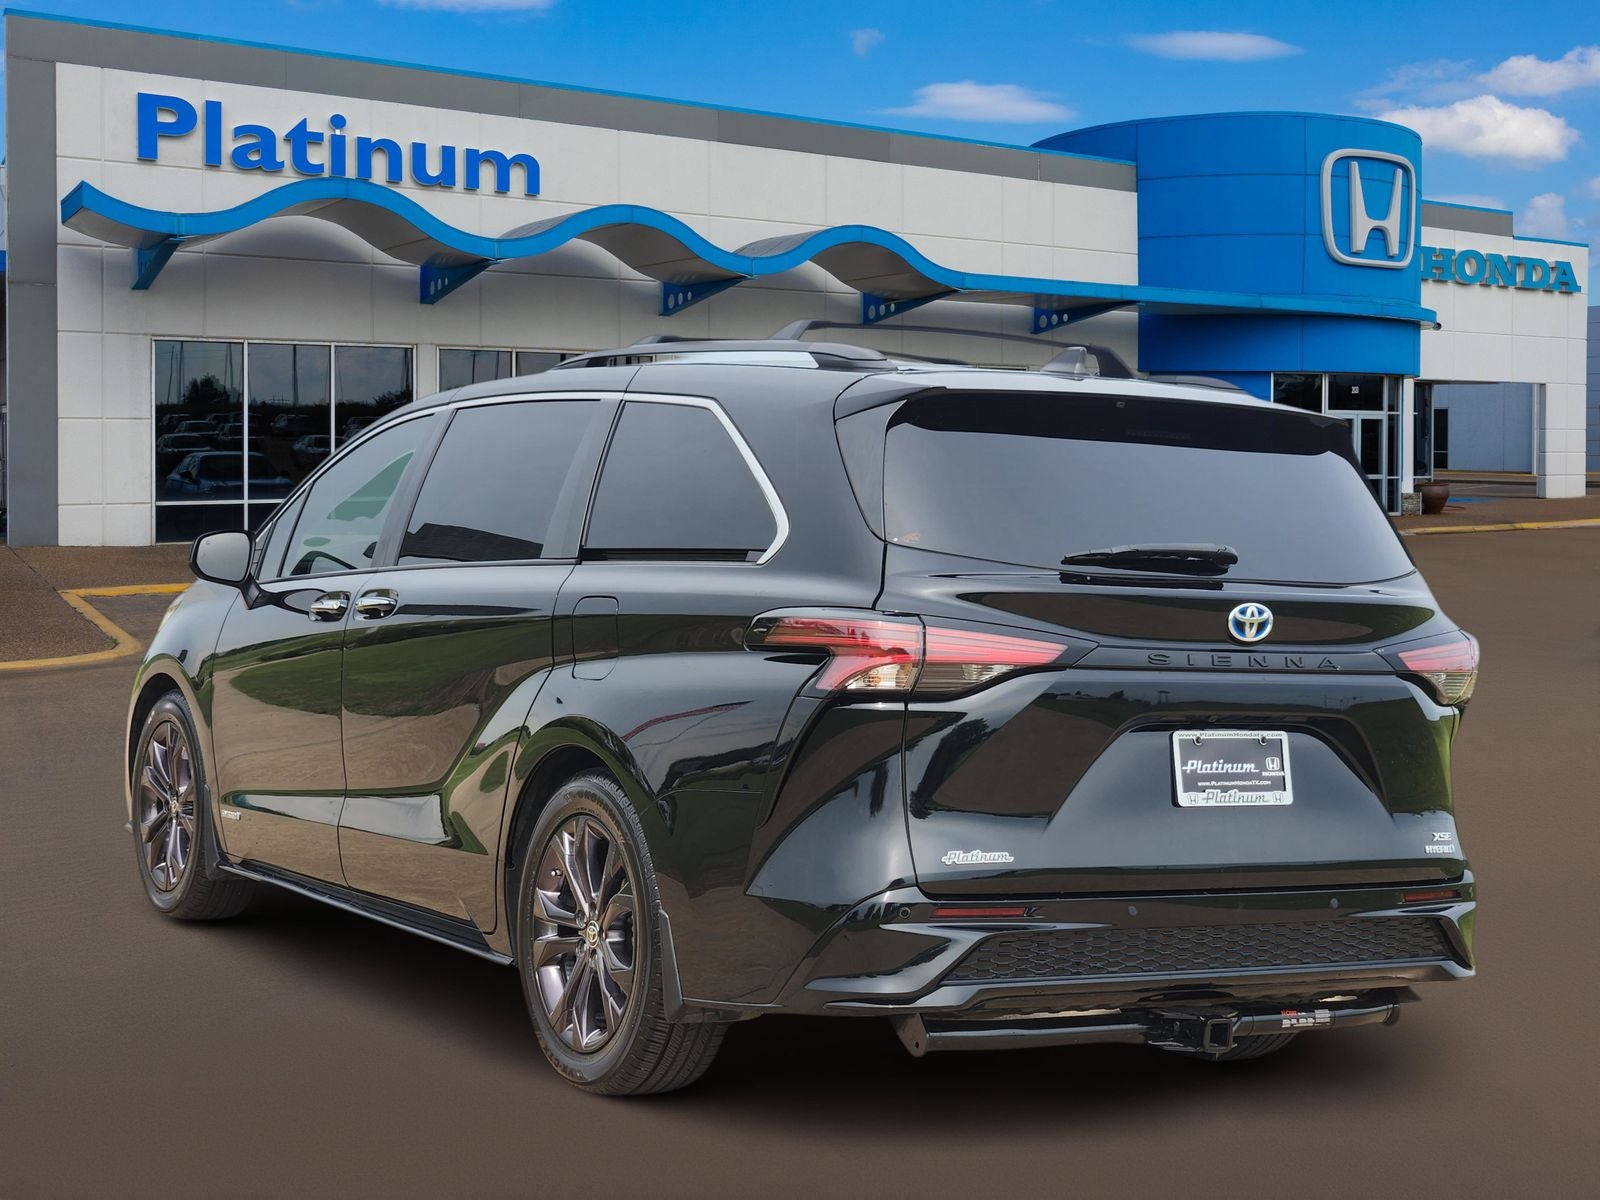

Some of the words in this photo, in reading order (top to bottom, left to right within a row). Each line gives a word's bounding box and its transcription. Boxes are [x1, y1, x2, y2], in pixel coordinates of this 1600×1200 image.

[137, 92, 540, 196] Platinum
[1421, 246, 1582, 293] HONDA
[1147, 653, 1340, 670] SIENNA
[1182, 760, 1260, 774] Platinum
[1201, 789, 1271, 804] Platinum
[1432, 832, 1452, 842] XSE
[941, 849, 1015, 866] Platinum
